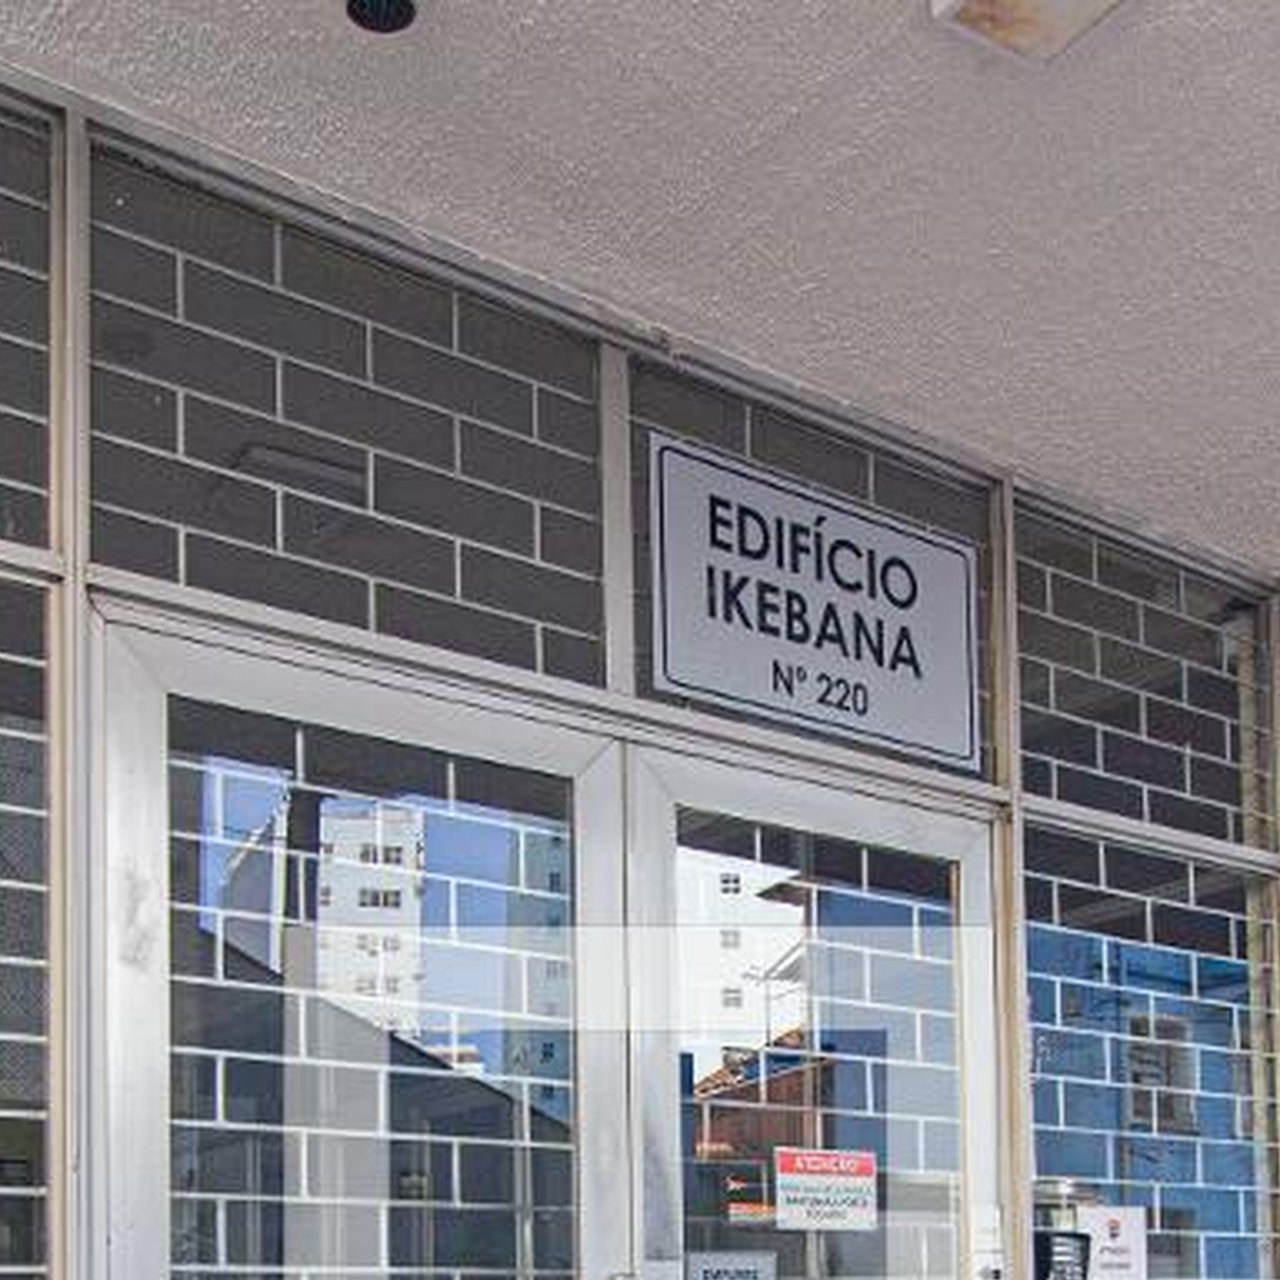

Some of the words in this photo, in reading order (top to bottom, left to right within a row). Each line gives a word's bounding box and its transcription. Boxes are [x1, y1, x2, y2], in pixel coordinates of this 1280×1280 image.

[708, 495, 919, 609] EDIFÍCIO
[707, 564, 922, 679] IKEBANA
[816, 672, 868, 715] 220
